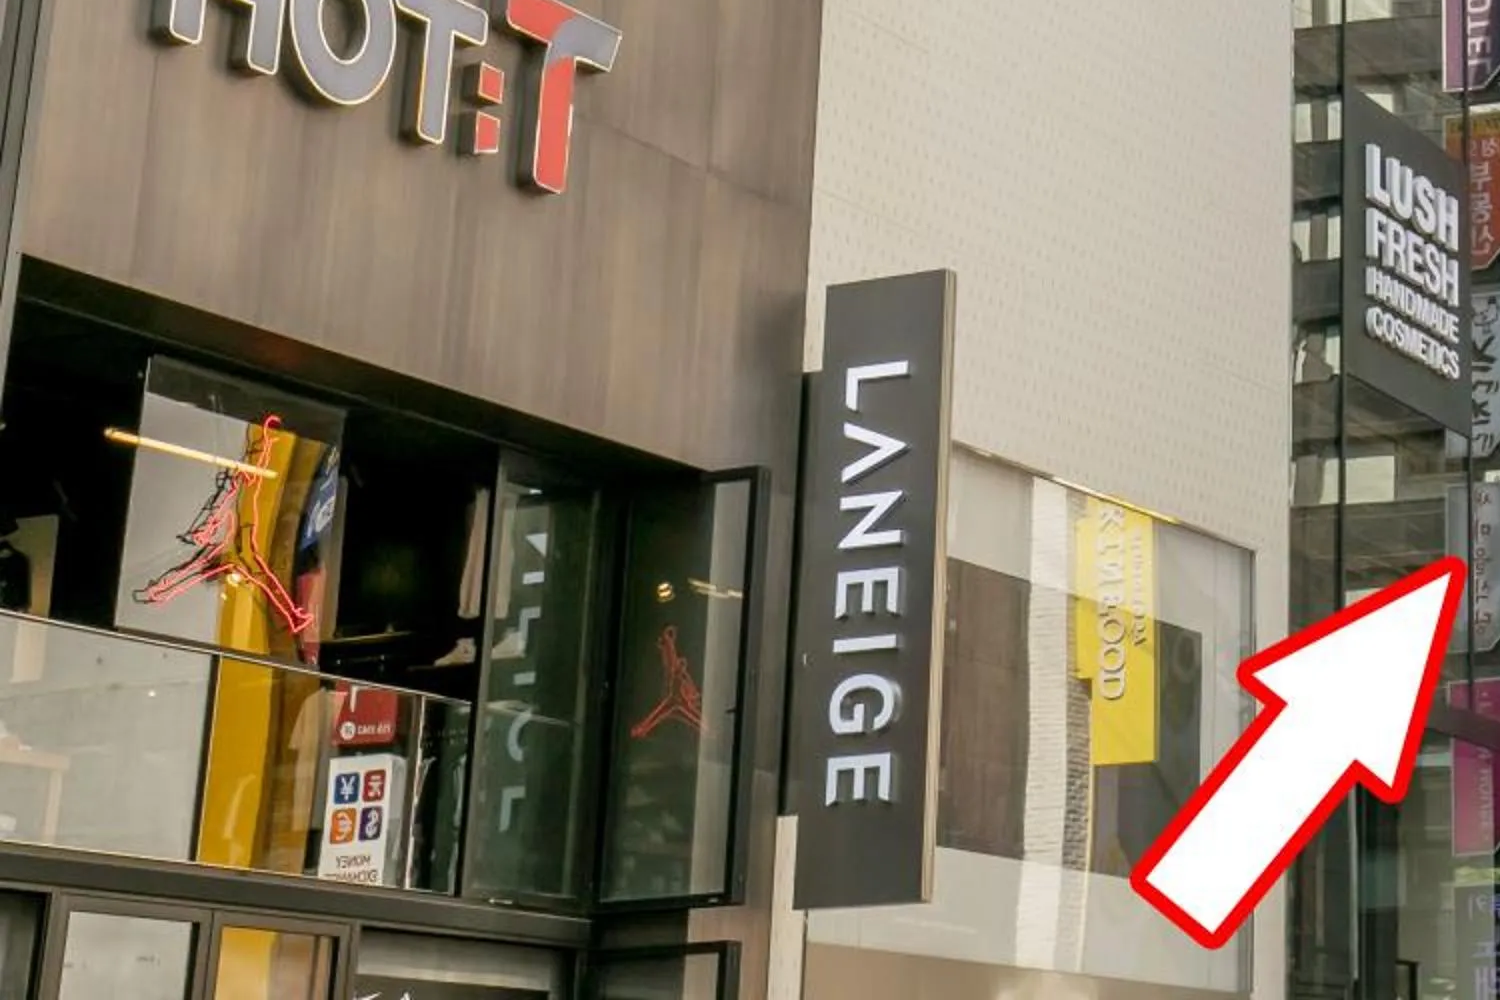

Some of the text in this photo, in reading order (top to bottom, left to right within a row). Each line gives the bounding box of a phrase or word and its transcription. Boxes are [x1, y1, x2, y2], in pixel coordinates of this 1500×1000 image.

[1365, 143, 1460, 252] LUSH
[1365, 206, 1460, 308] FRESH
[1365, 265, 1460, 345] HANDMADE
[1365, 305, 1460, 380] COSMETICS
[824, 359, 910, 807] LANEIGE
